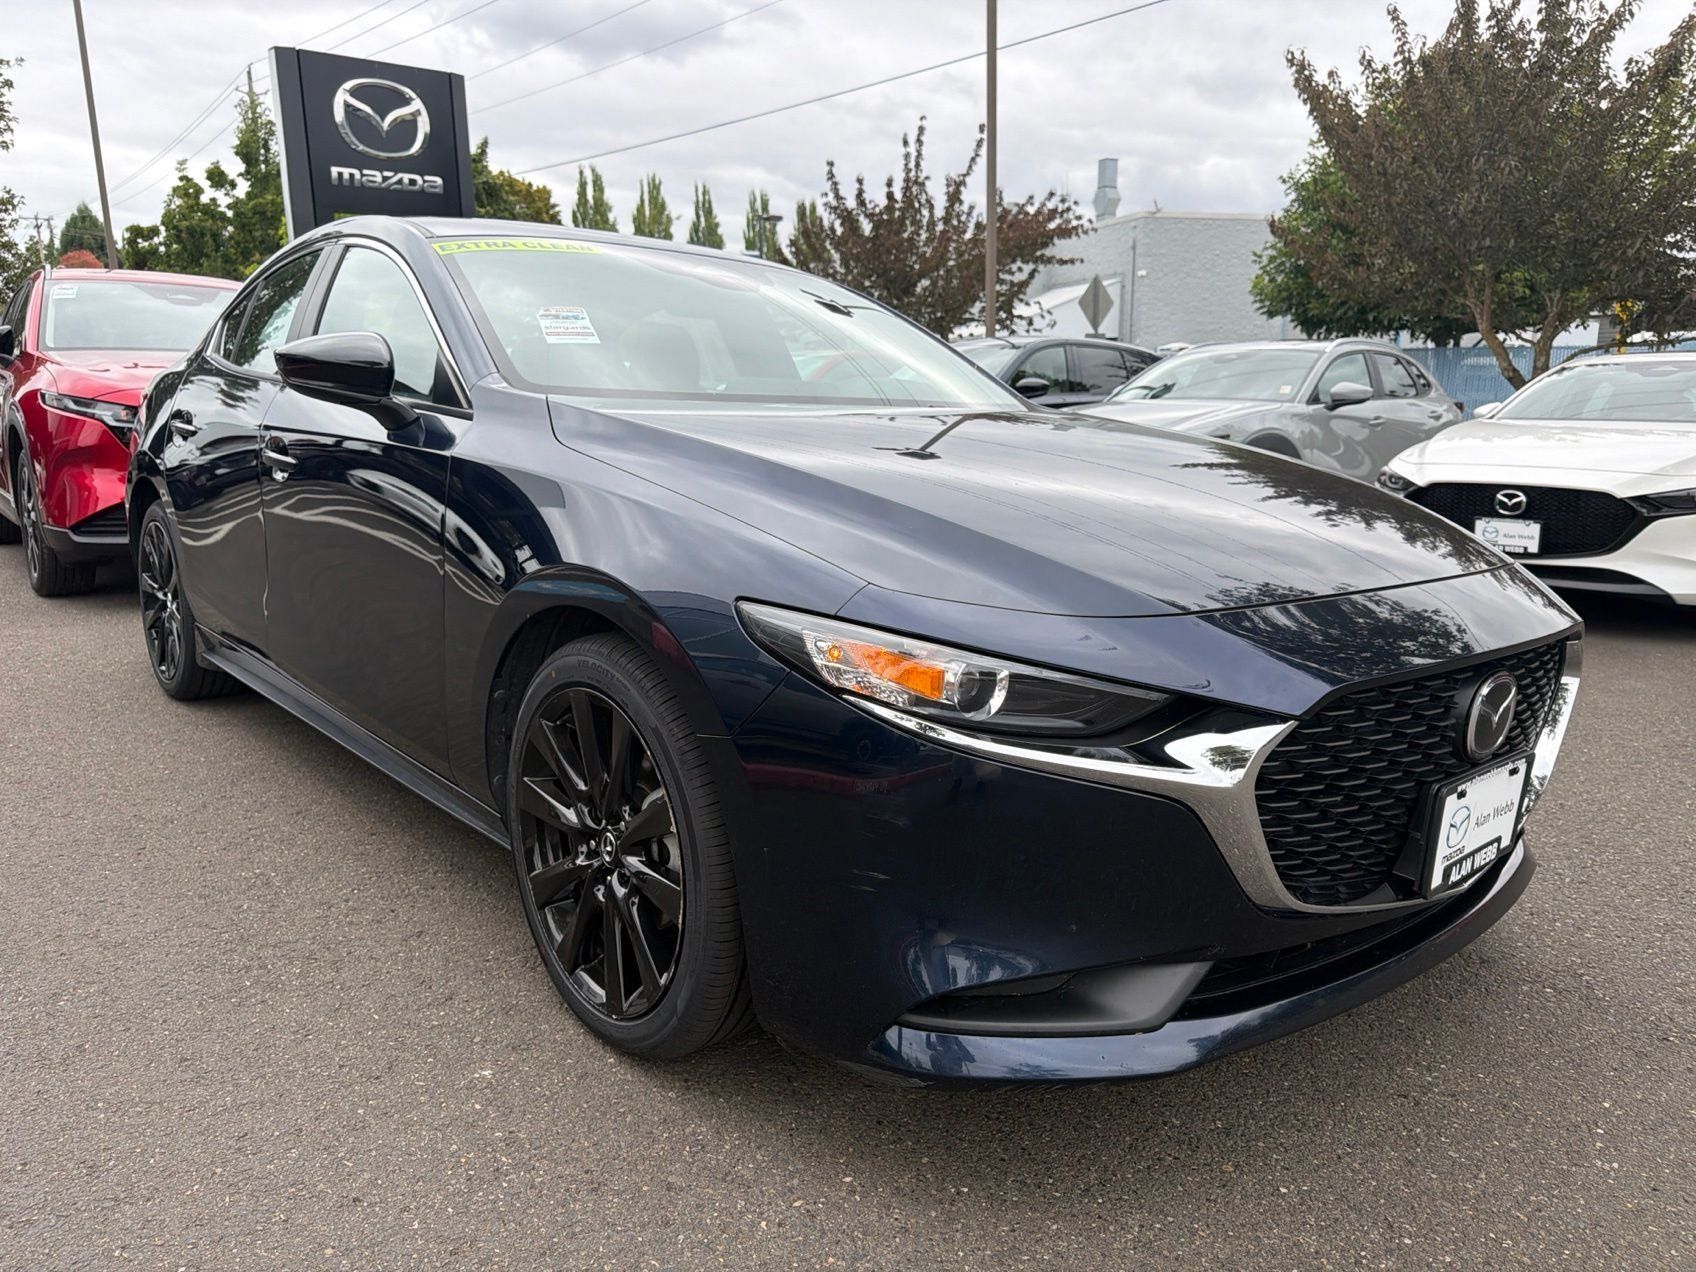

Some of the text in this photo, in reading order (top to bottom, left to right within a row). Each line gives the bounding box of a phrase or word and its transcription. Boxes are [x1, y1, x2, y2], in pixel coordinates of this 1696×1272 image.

[438, 241, 593, 253] EXTRA CLEAN
[577, 659, 616, 681] VELOCITY
[1473, 800, 1515, 832] Alan Webb
[1449, 842, 1498, 885] ALAN WEBB
